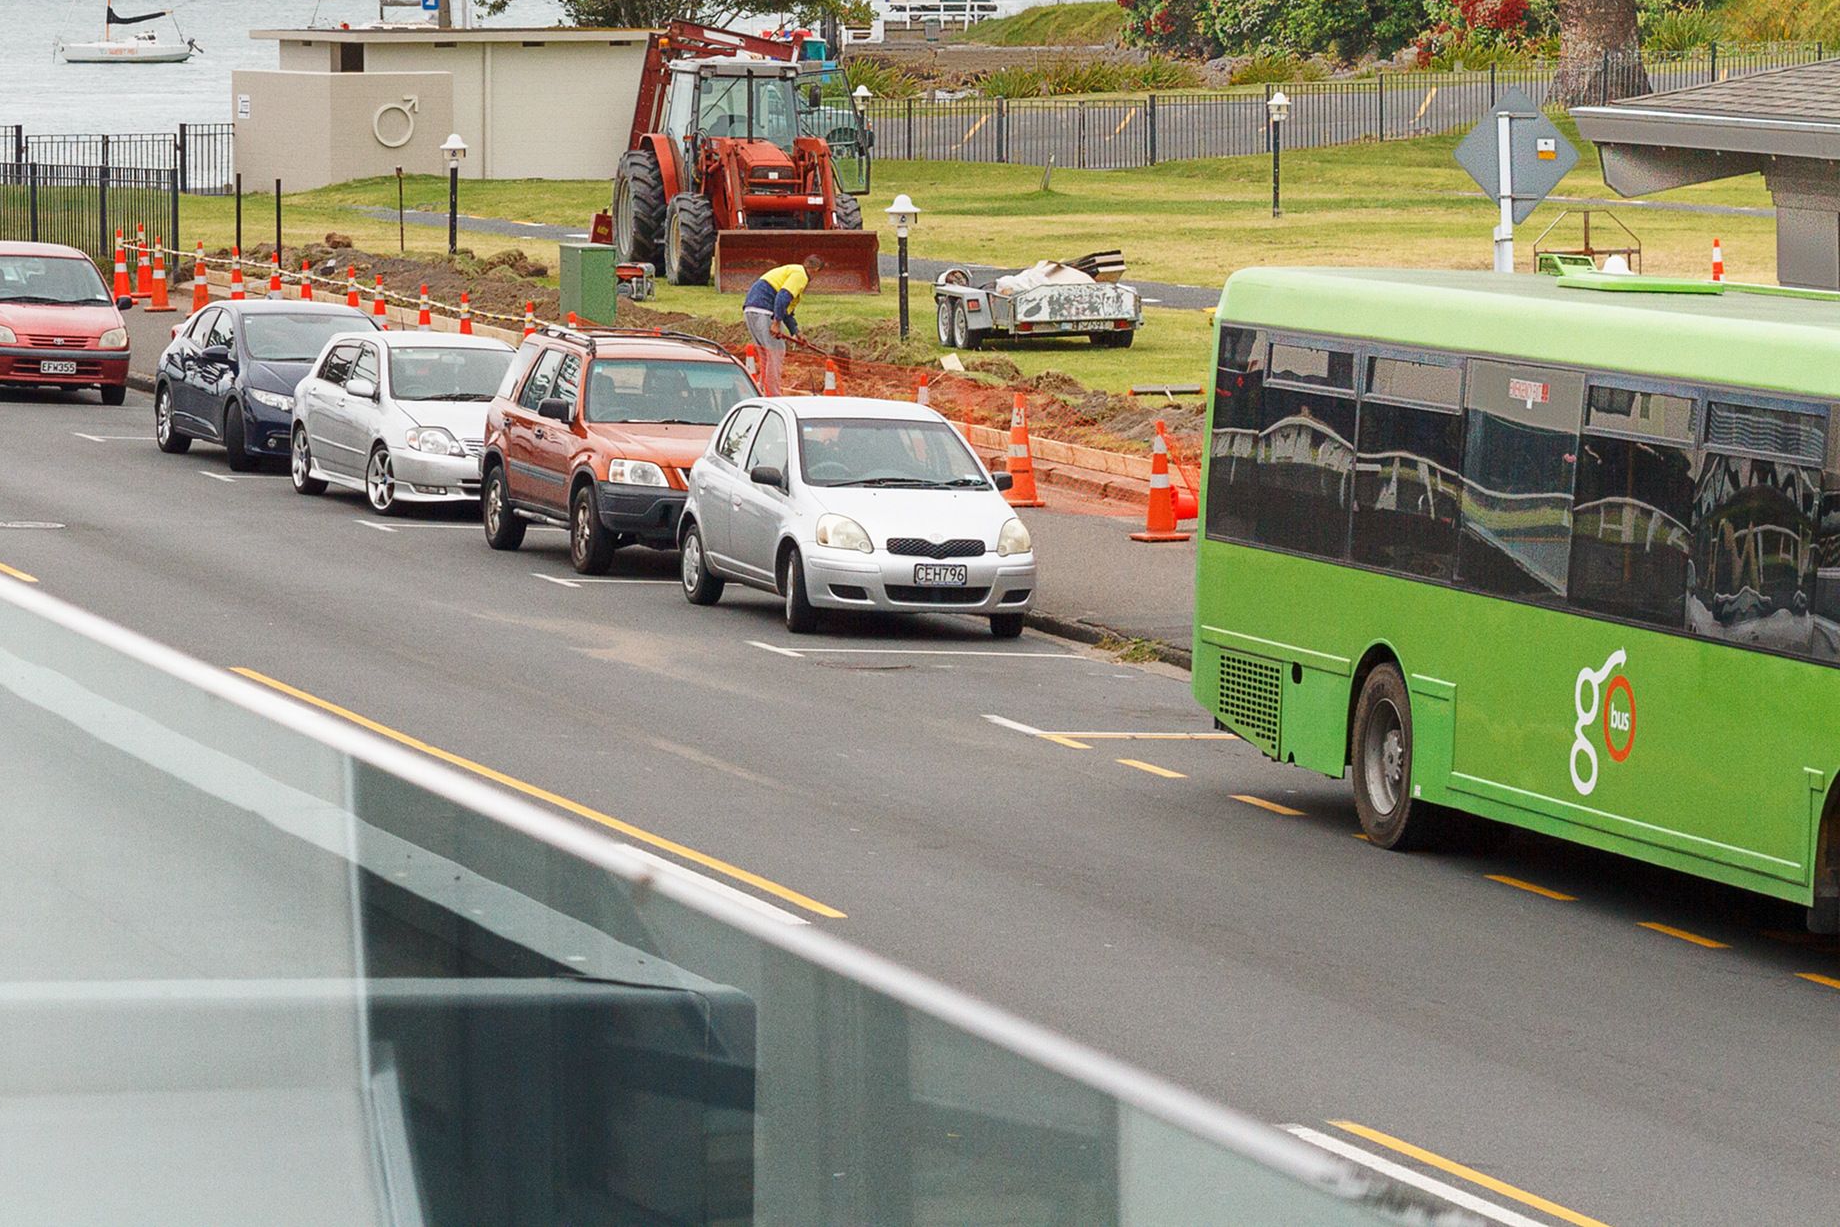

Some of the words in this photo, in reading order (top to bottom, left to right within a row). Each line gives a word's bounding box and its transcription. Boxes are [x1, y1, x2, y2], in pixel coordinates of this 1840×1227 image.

[42, 362, 75, 372] EFW355
[917, 567, 965, 582] CEH796
[1611, 702, 1630, 731] bus
